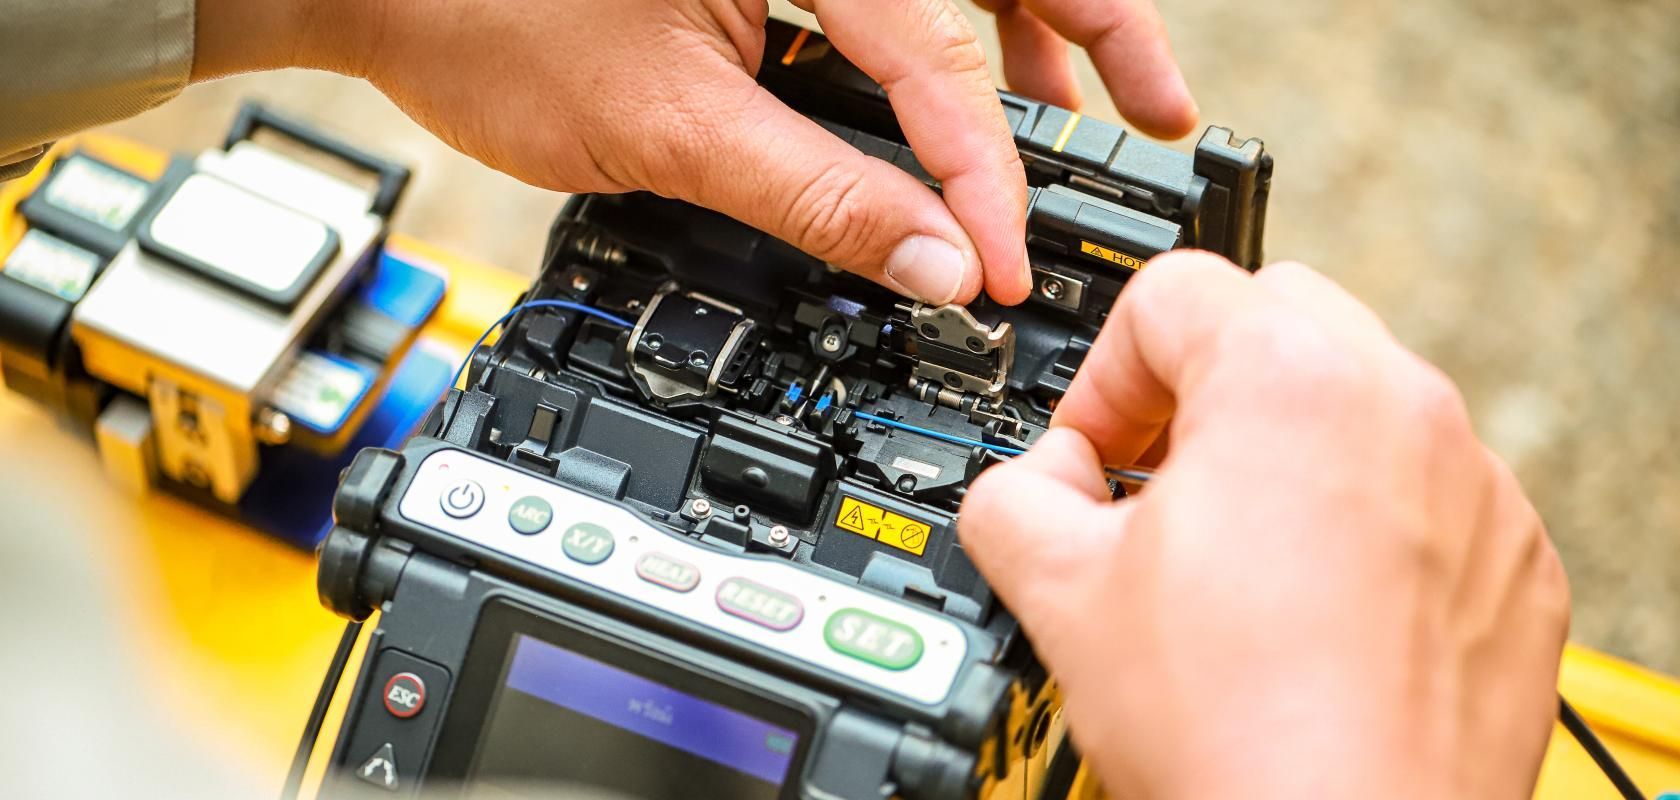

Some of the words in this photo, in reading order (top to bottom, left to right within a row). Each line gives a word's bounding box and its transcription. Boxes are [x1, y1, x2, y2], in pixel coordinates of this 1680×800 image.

[1112, 252, 1145, 270] HOT
[568, 528, 609, 554] X/Y
[719, 581, 796, 621] RESET
[833, 615, 911, 657] SET
[387, 684, 421, 708] ESC
